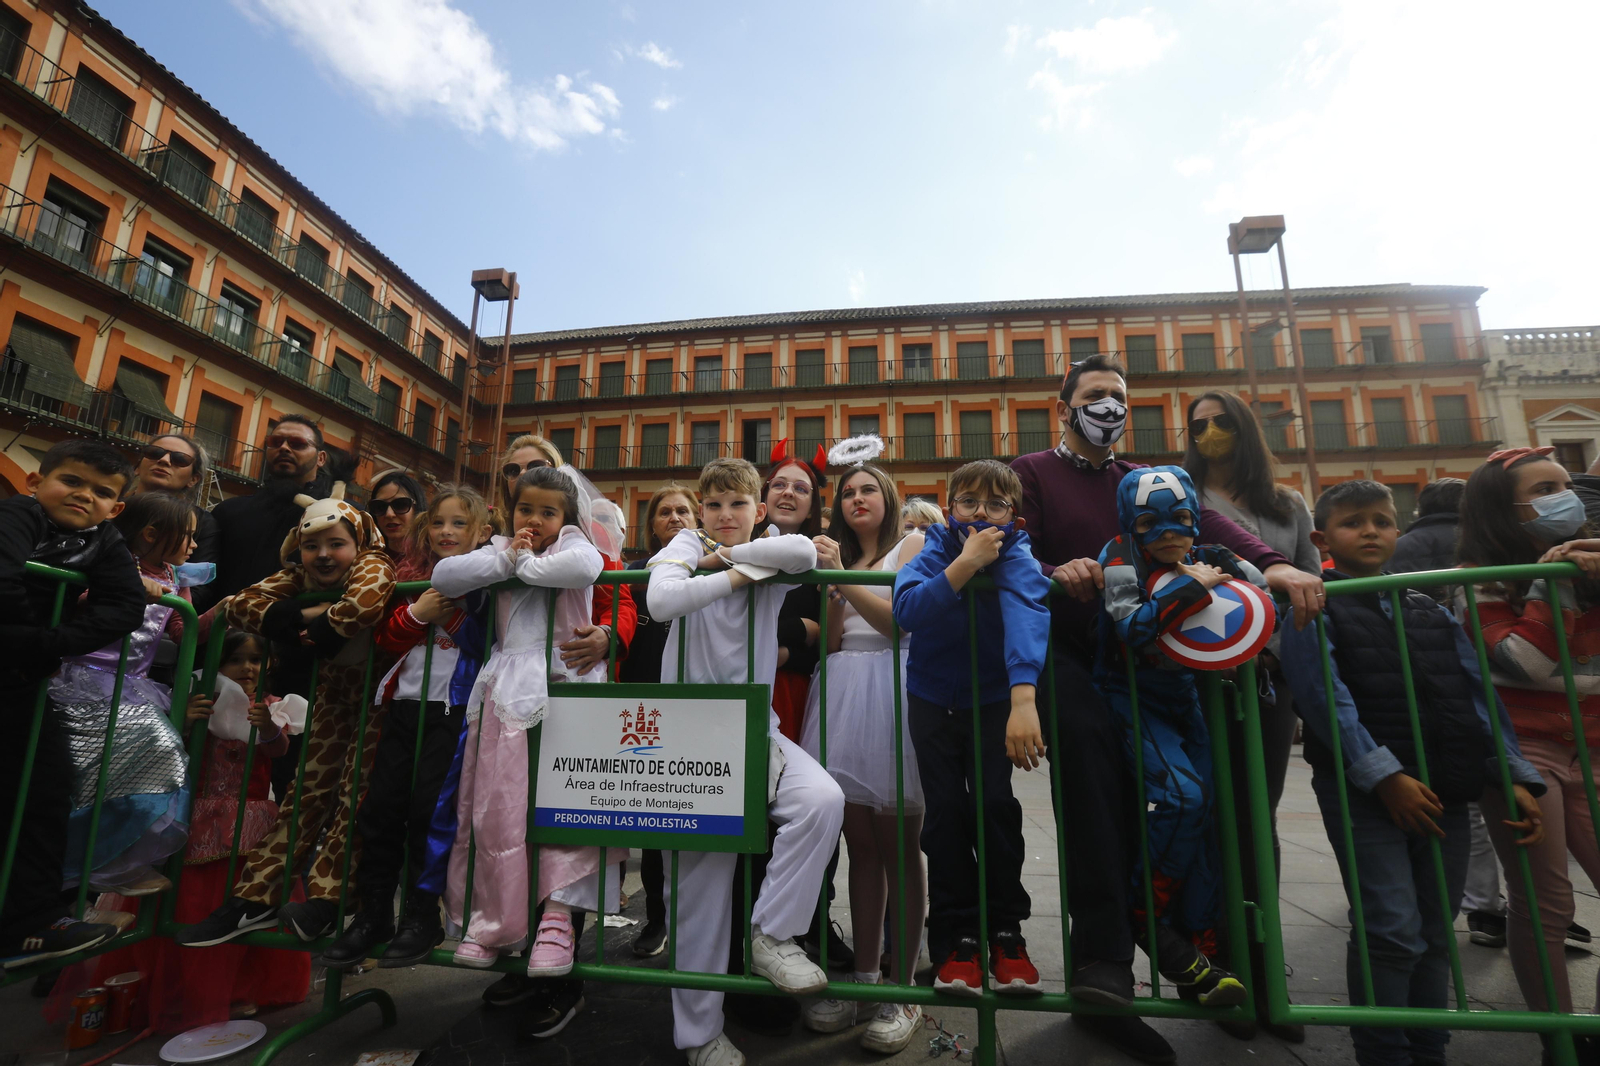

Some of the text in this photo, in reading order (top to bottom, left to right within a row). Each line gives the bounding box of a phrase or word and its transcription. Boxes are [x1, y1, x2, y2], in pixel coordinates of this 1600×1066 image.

[552, 757, 731, 777] AYUNTAMIENTO DE CÓRDOBA
[564, 775, 724, 795] Área de Infraestructuras
[590, 796, 694, 811] Equipo de Montajes
[554, 813, 698, 829] PERDONEN LAS MOLESTIAS
